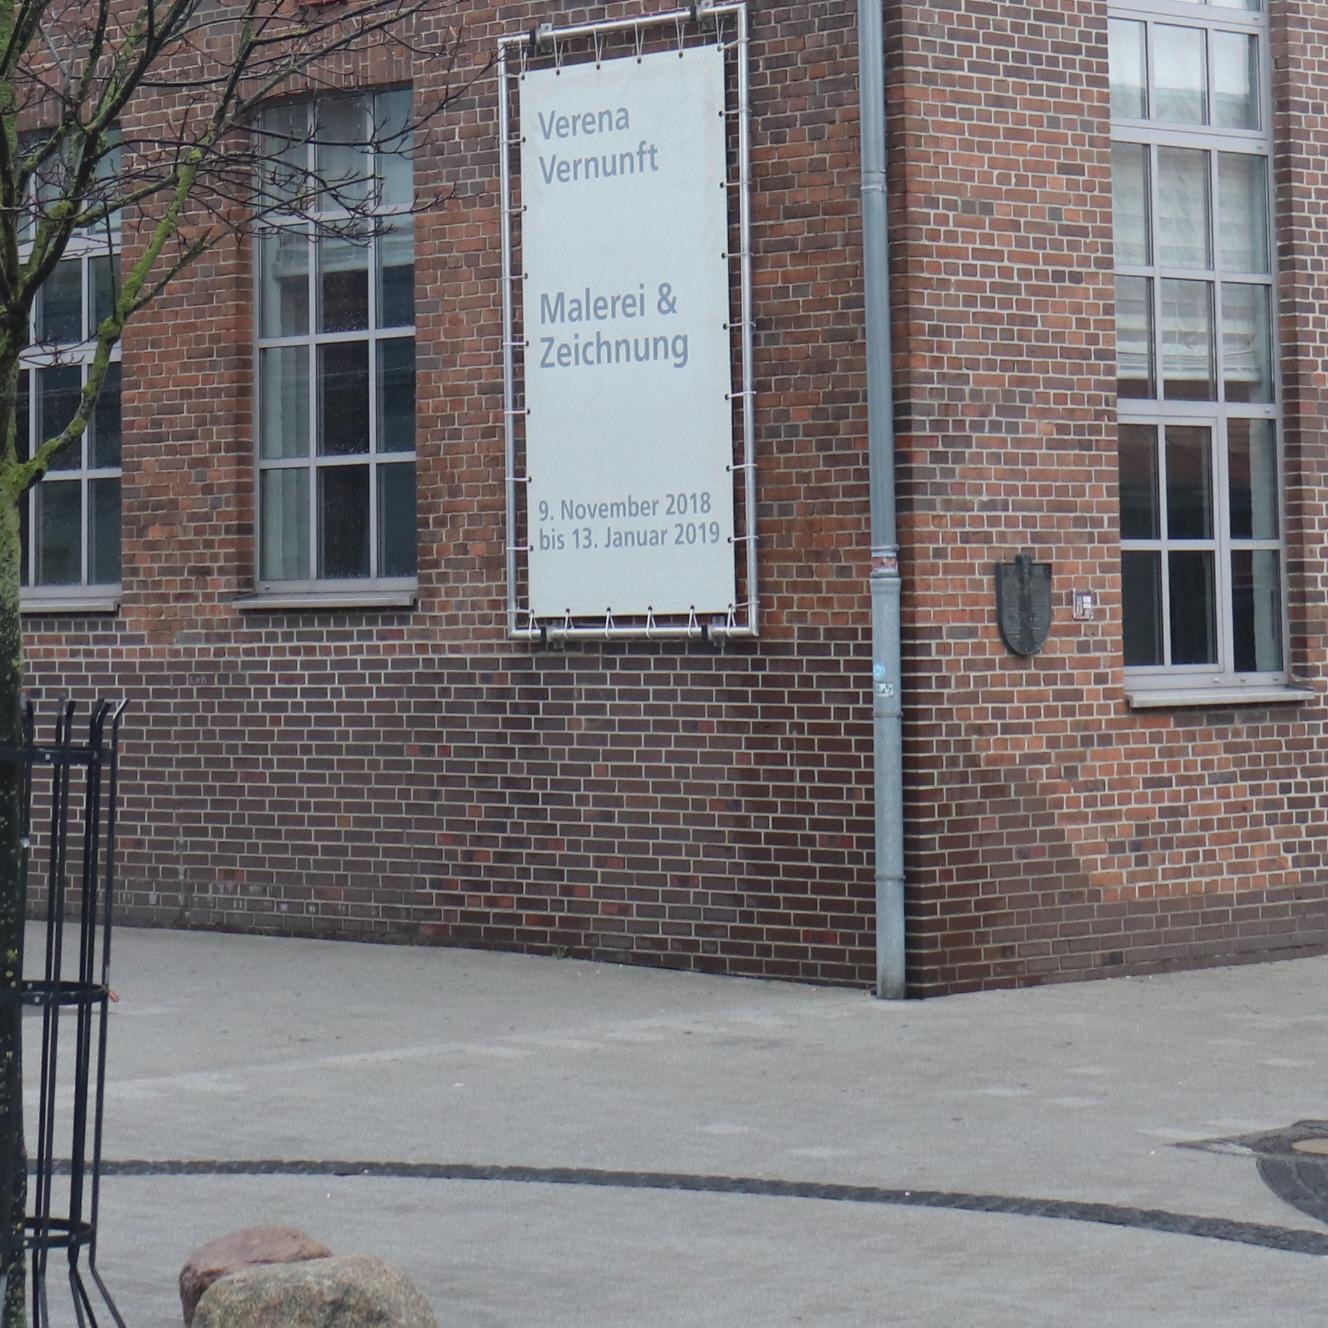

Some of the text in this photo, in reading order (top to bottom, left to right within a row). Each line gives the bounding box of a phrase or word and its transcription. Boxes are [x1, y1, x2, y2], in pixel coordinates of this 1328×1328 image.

[537, 107, 630, 140] Verena
[538, 140, 659, 185] Vernunft
[540, 281, 678, 325] Malerei &
[540, 331, 688, 369] Zeichnung
[538, 491, 712, 522] 9. November 2018
[539, 521, 721, 551] bis 13. Januar 2019
